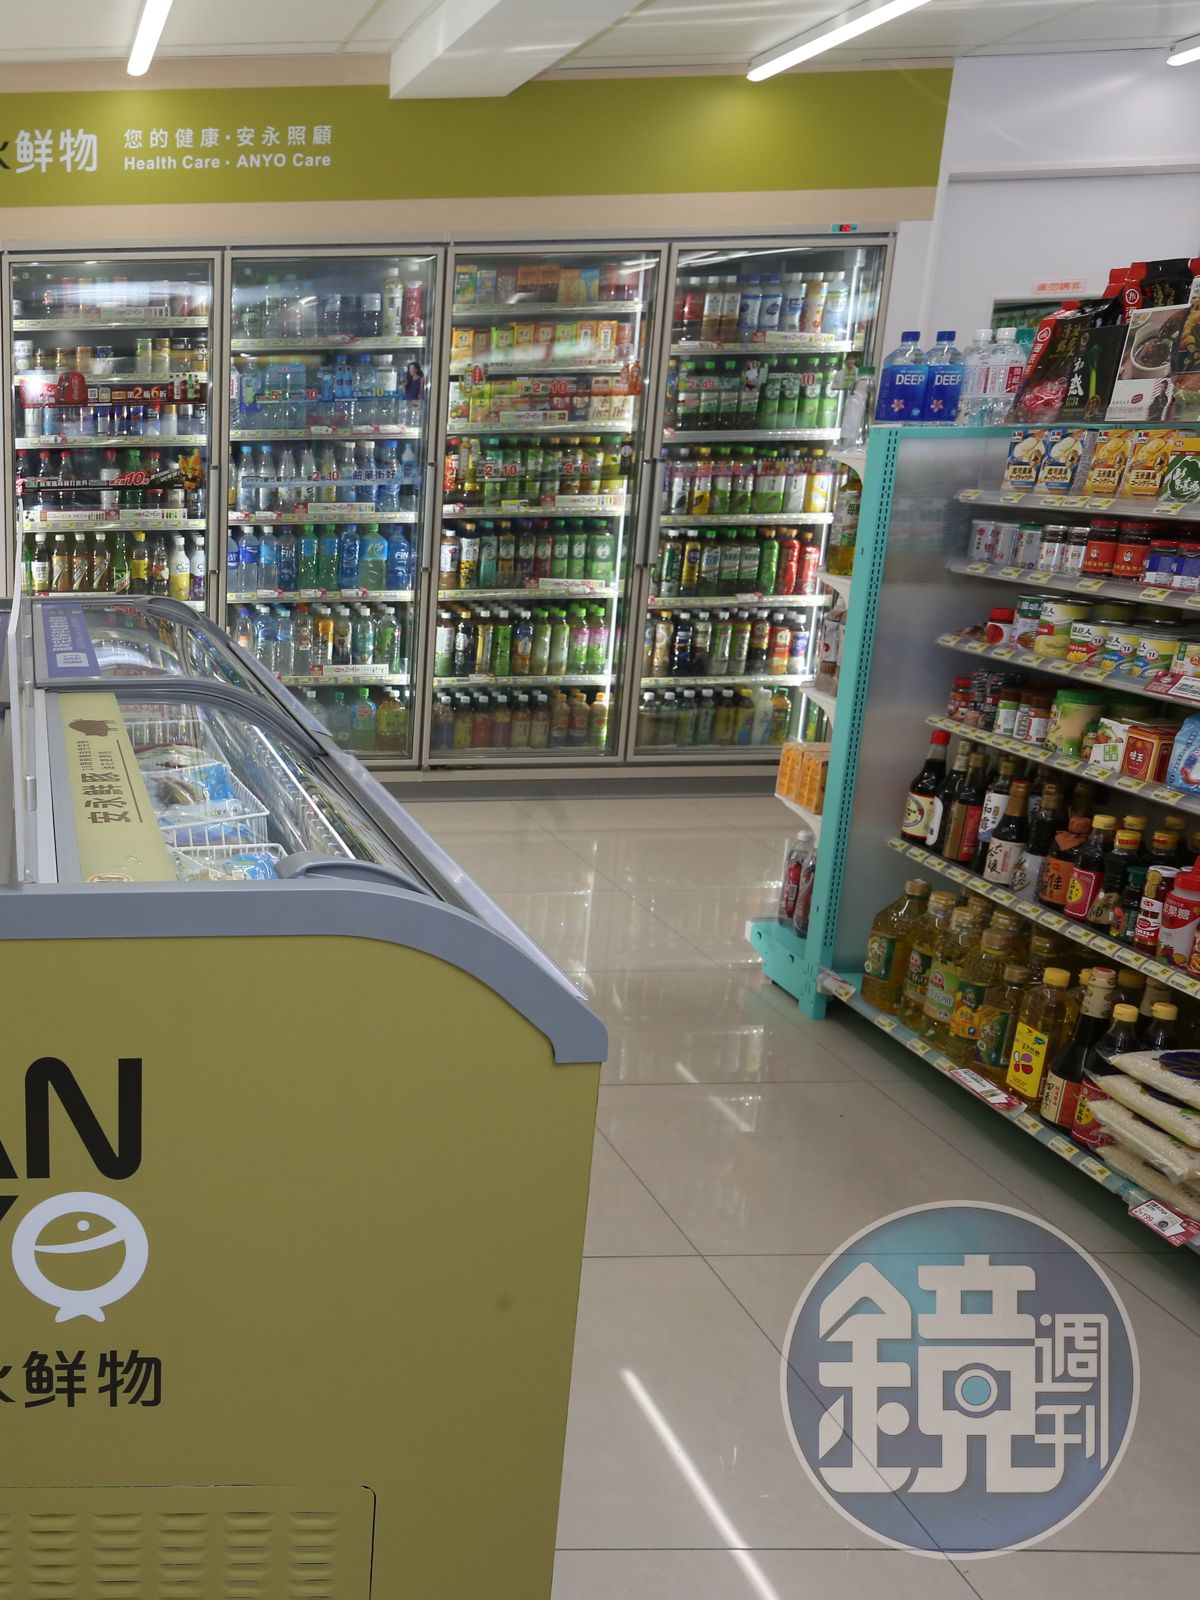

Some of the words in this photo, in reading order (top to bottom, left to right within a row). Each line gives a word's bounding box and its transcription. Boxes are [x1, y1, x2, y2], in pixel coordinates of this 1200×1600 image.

[124, 156, 177, 170] Health
[182, 156, 220, 170] Care
[236, 153, 286, 168] ANYO
[292, 152, 332, 167] Care
[895, 374, 925, 385] DEEP
